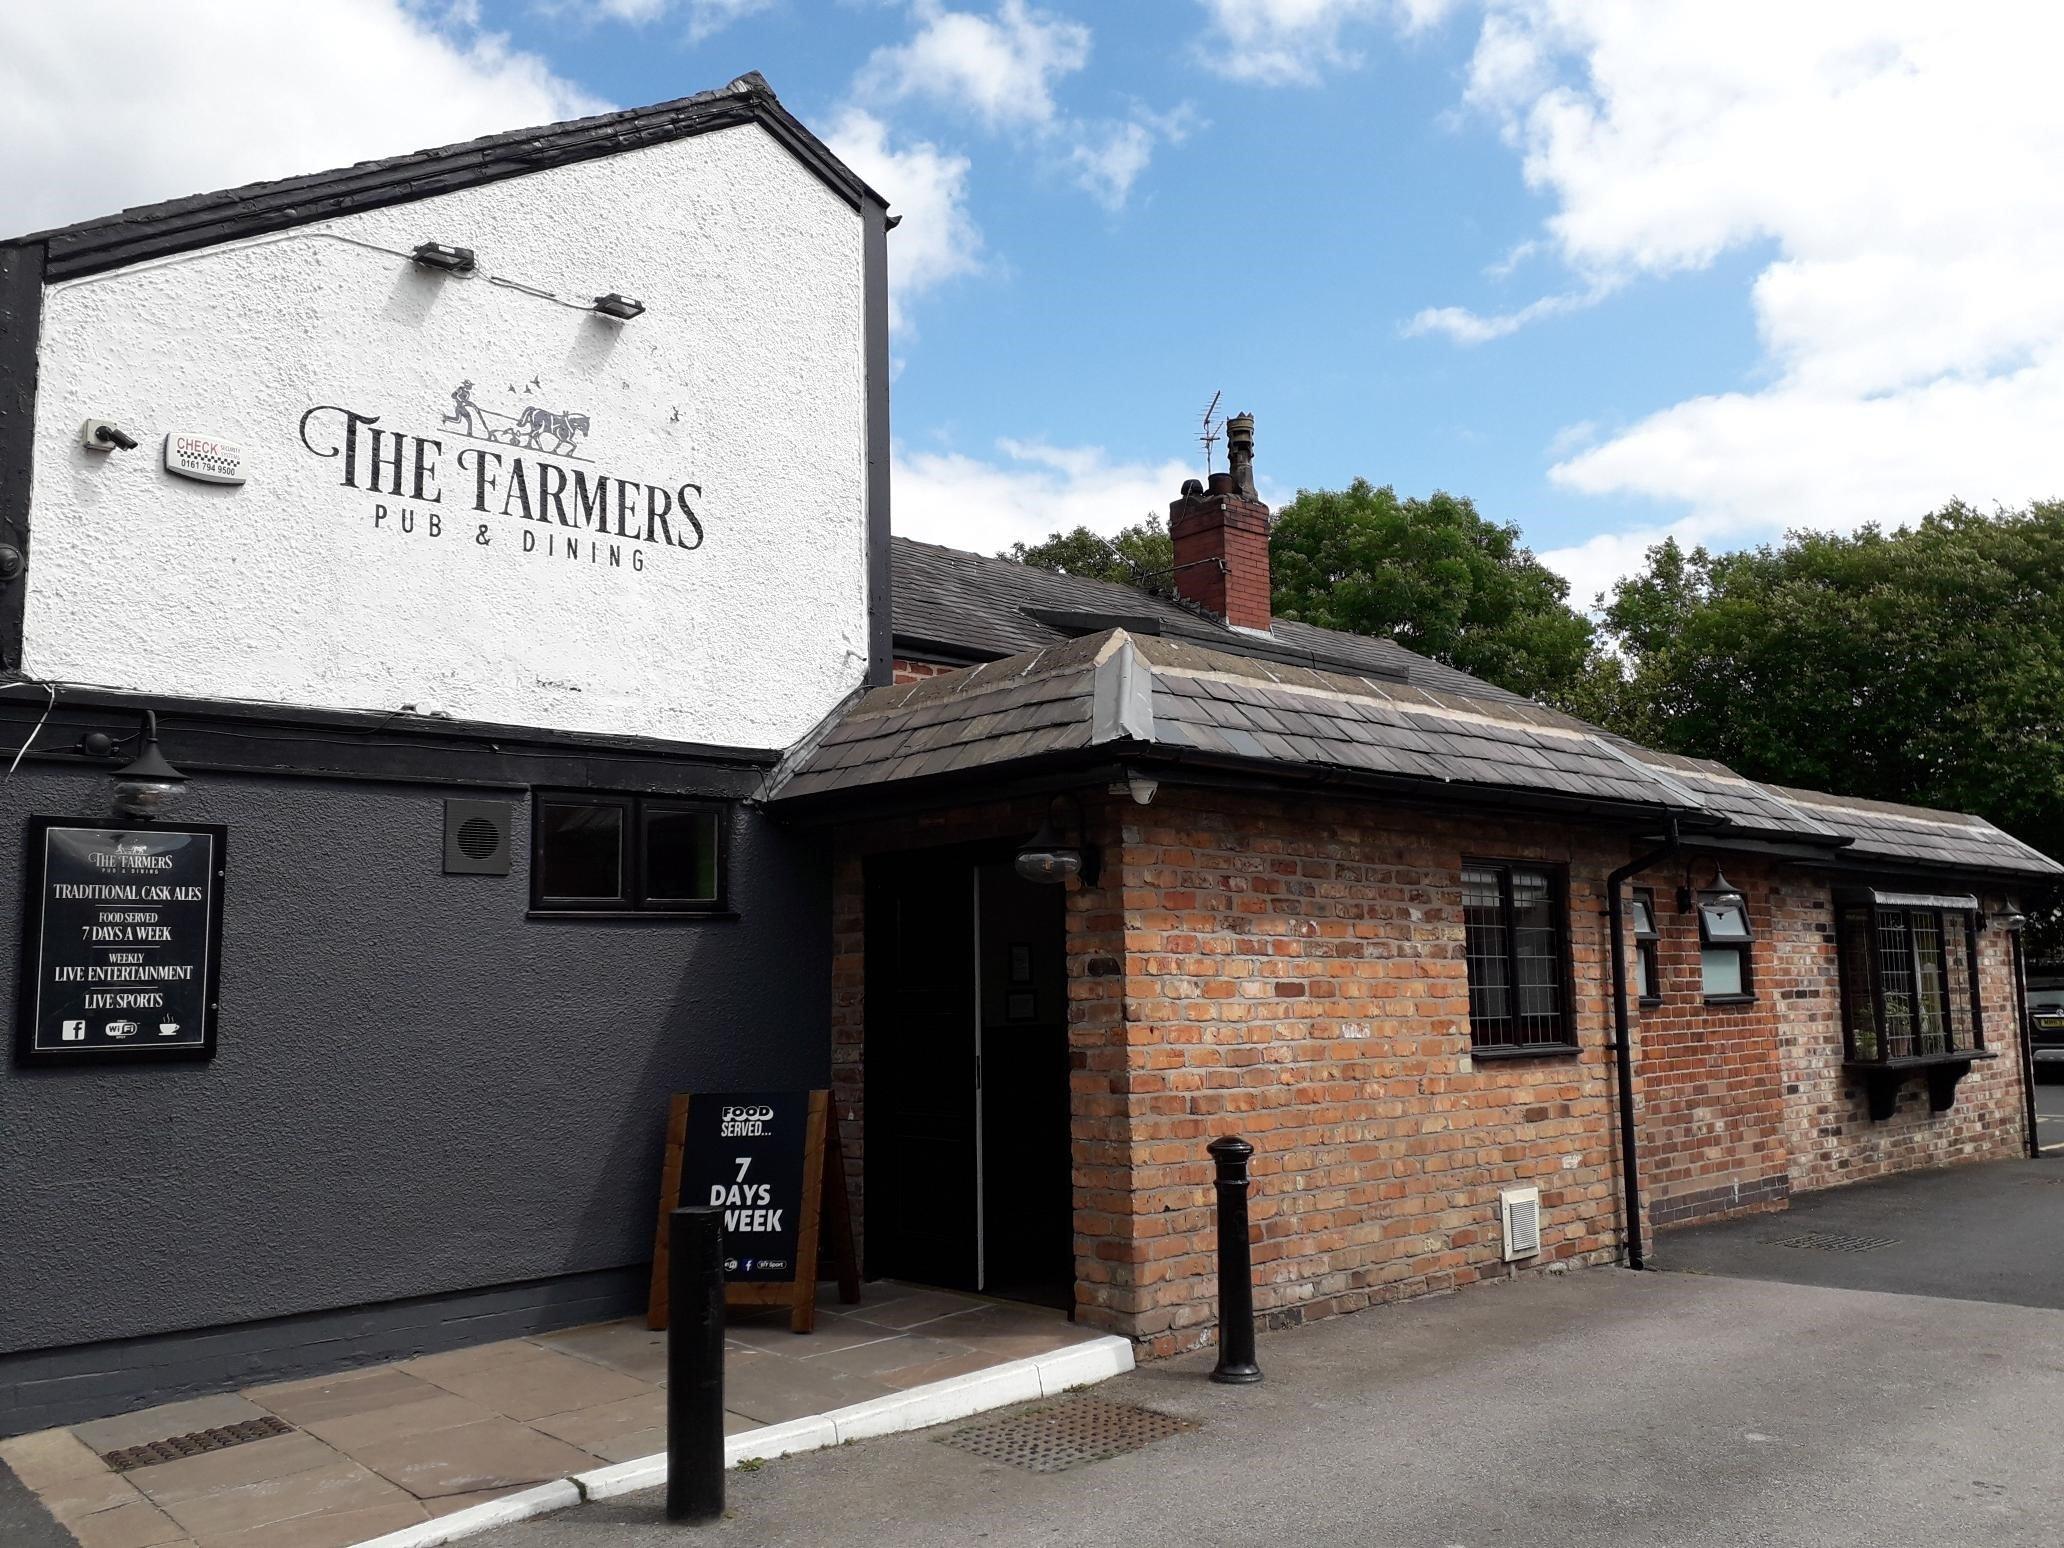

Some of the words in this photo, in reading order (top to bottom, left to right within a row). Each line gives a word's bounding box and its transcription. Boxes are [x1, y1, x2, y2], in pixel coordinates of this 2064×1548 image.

[177, 437, 219, 455] CHECK
[181, 458, 199, 469] 0161
[202, 462, 216, 472] 794
[217, 465, 235, 476] 9500
[300, 405, 442, 503] THE
[457, 448, 704, 550] FARMERS
[374, 504, 441, 538] PUB
[475, 524, 491, 546] &
[523, 529, 644, 571] DINING
[88, 852, 117, 867] THE
[118, 854, 173, 869] FARMERS
[53, 884, 139, 899] TRADITIONAL
[141, 885, 171, 900] CASK
[173, 886, 202, 901] ALES
[99, 912, 123, 922] FOOD
[124, 912, 158, 923] SERVED
[82, 926, 90, 940] 7
[92, 926, 122, 941] DAYS
[124, 926, 133, 941] A
[136, 926, 172, 941] WEEK
[109, 953, 144, 964] WEEKLY
[55, 966, 85, 981] LIVE
[87, 965, 193, 981] ENTERTAINMENT
[84, 994, 114, 1009] LIVE
[116, 993, 163, 1008] SPORTS
[722, 1105, 774, 1121] FOOD
[721, 1121, 772, 1137] SERVED...
[735, 1157, 752, 1183] 7
[710, 1184, 771, 1206] DAYS
